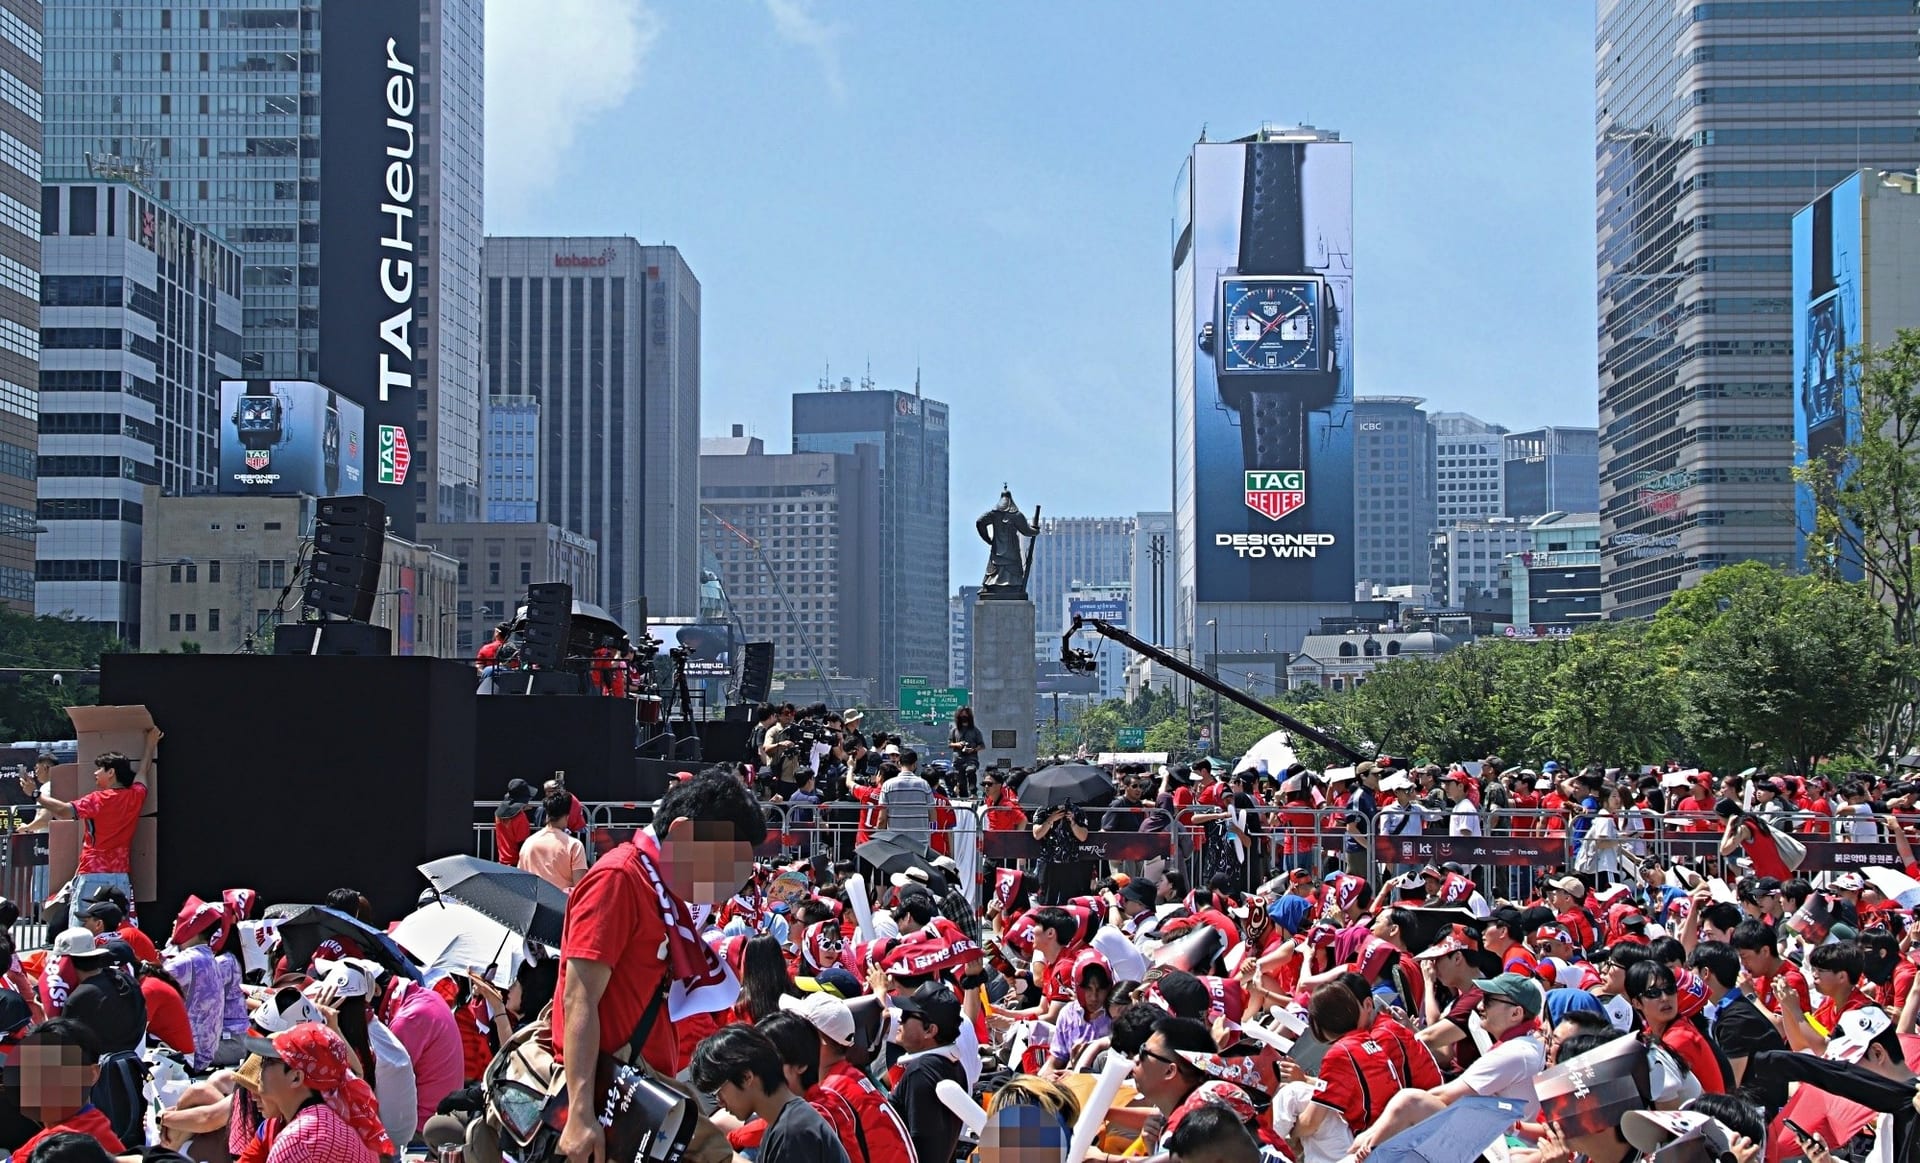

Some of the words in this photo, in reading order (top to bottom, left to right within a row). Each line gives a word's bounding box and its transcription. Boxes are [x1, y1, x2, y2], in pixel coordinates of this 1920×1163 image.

[555, 252, 606, 267] kobaco
[1359, 422, 1382, 431] ICBC
[249, 450, 268, 458] TAG
[381, 429, 394, 482] TAG
[394, 427, 409, 483] HEUER
[1250, 473, 1299, 489] TAG
[1248, 493, 1302, 517] HEUER
[1215, 533, 1335, 546] DESIGNED
[1233, 546, 1266, 558] TO
[1271, 546, 1316, 558] WIN
[1419, 843, 1432, 854] kt
[1834, 853, 1867, 863] 붉은악마
[1869, 854, 1894, 864] 응원존
